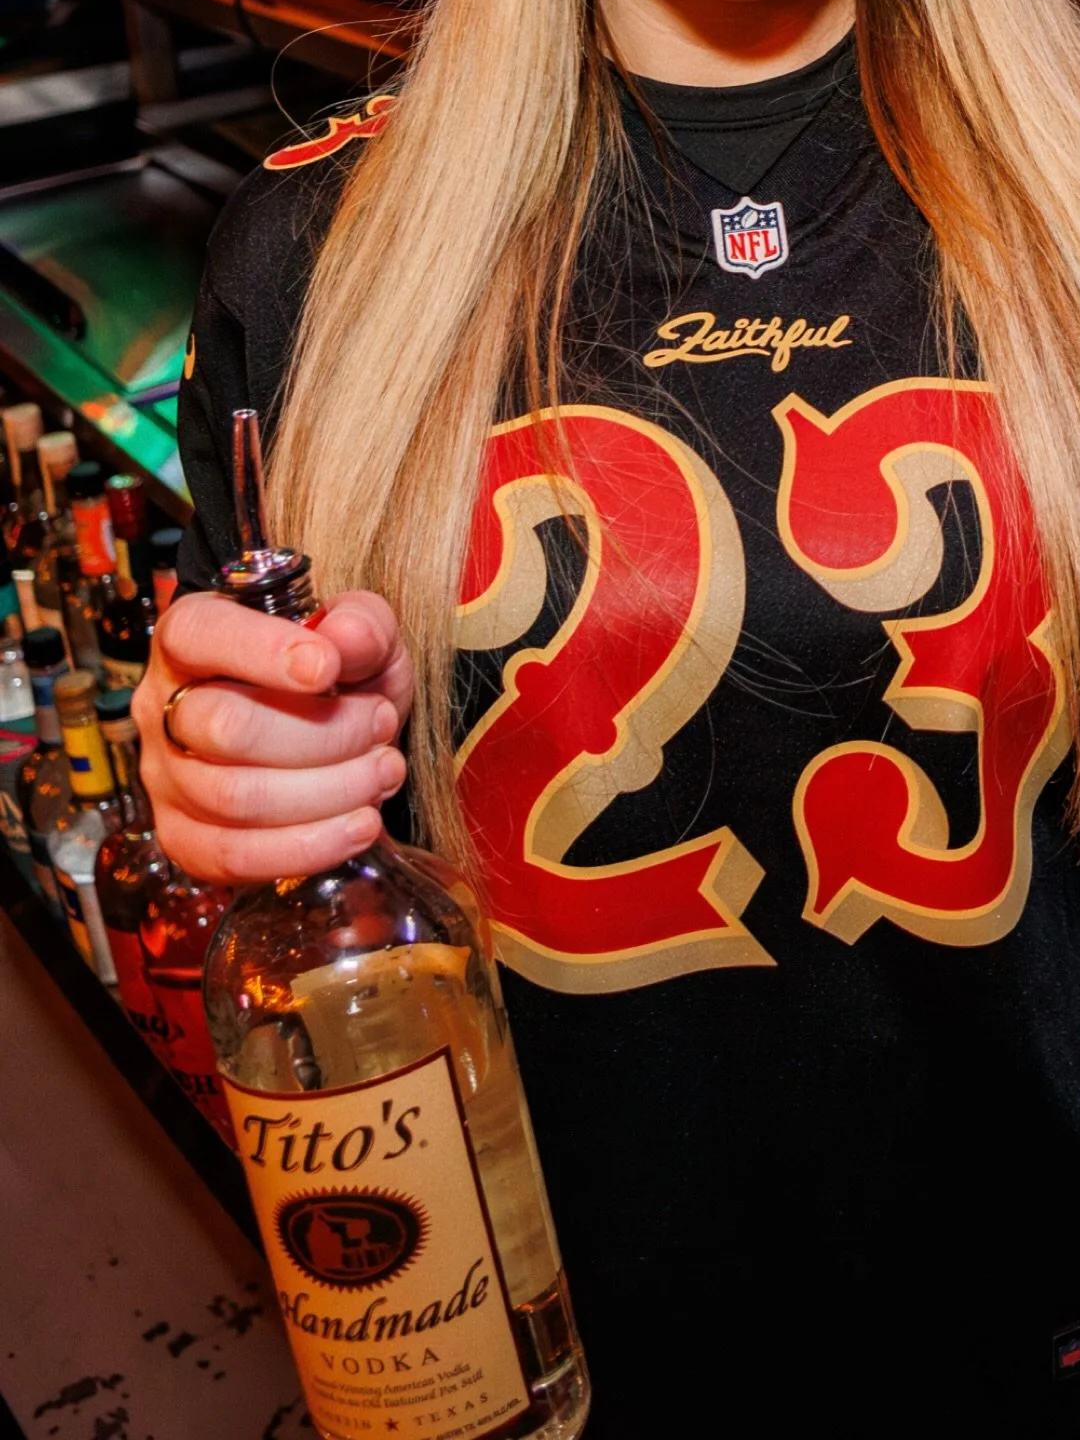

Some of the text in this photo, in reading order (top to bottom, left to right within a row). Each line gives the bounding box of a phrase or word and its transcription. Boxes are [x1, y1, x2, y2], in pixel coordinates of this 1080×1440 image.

[727, 229, 778, 262] NFL
[643, 311, 853, 373] Faithful
[454, 376, 1072, 994] 23
[243, 1099, 422, 1175] Tito's
[279, 1256, 491, 1343] Handmade
[320, 1346, 441, 1376] VODKA
[413, 1391, 489, 1427] TEXAS
